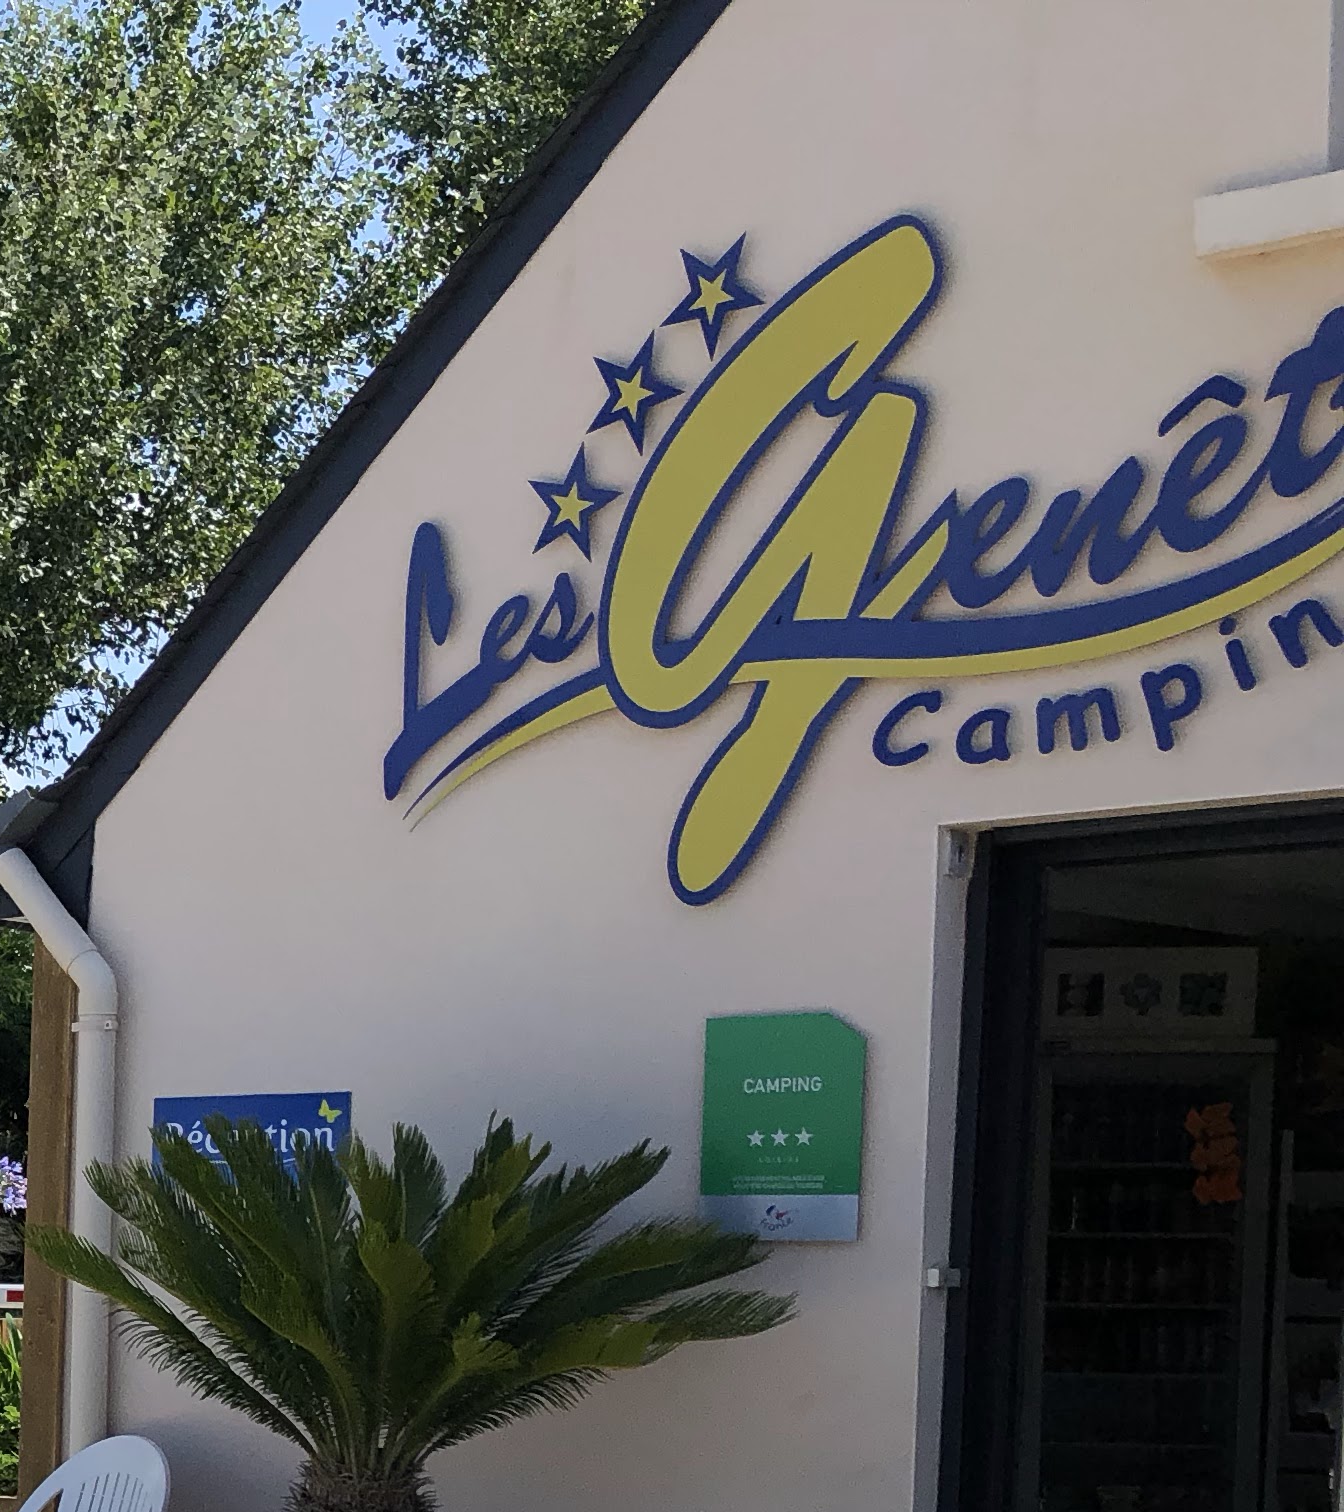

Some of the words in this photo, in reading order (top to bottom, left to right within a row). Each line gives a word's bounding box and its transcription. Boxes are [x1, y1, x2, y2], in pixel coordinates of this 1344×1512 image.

[383, 521, 595, 801] Les
[599, 213, 1344, 907] Genêt
[743, 1075, 823, 1094] CAMPING
